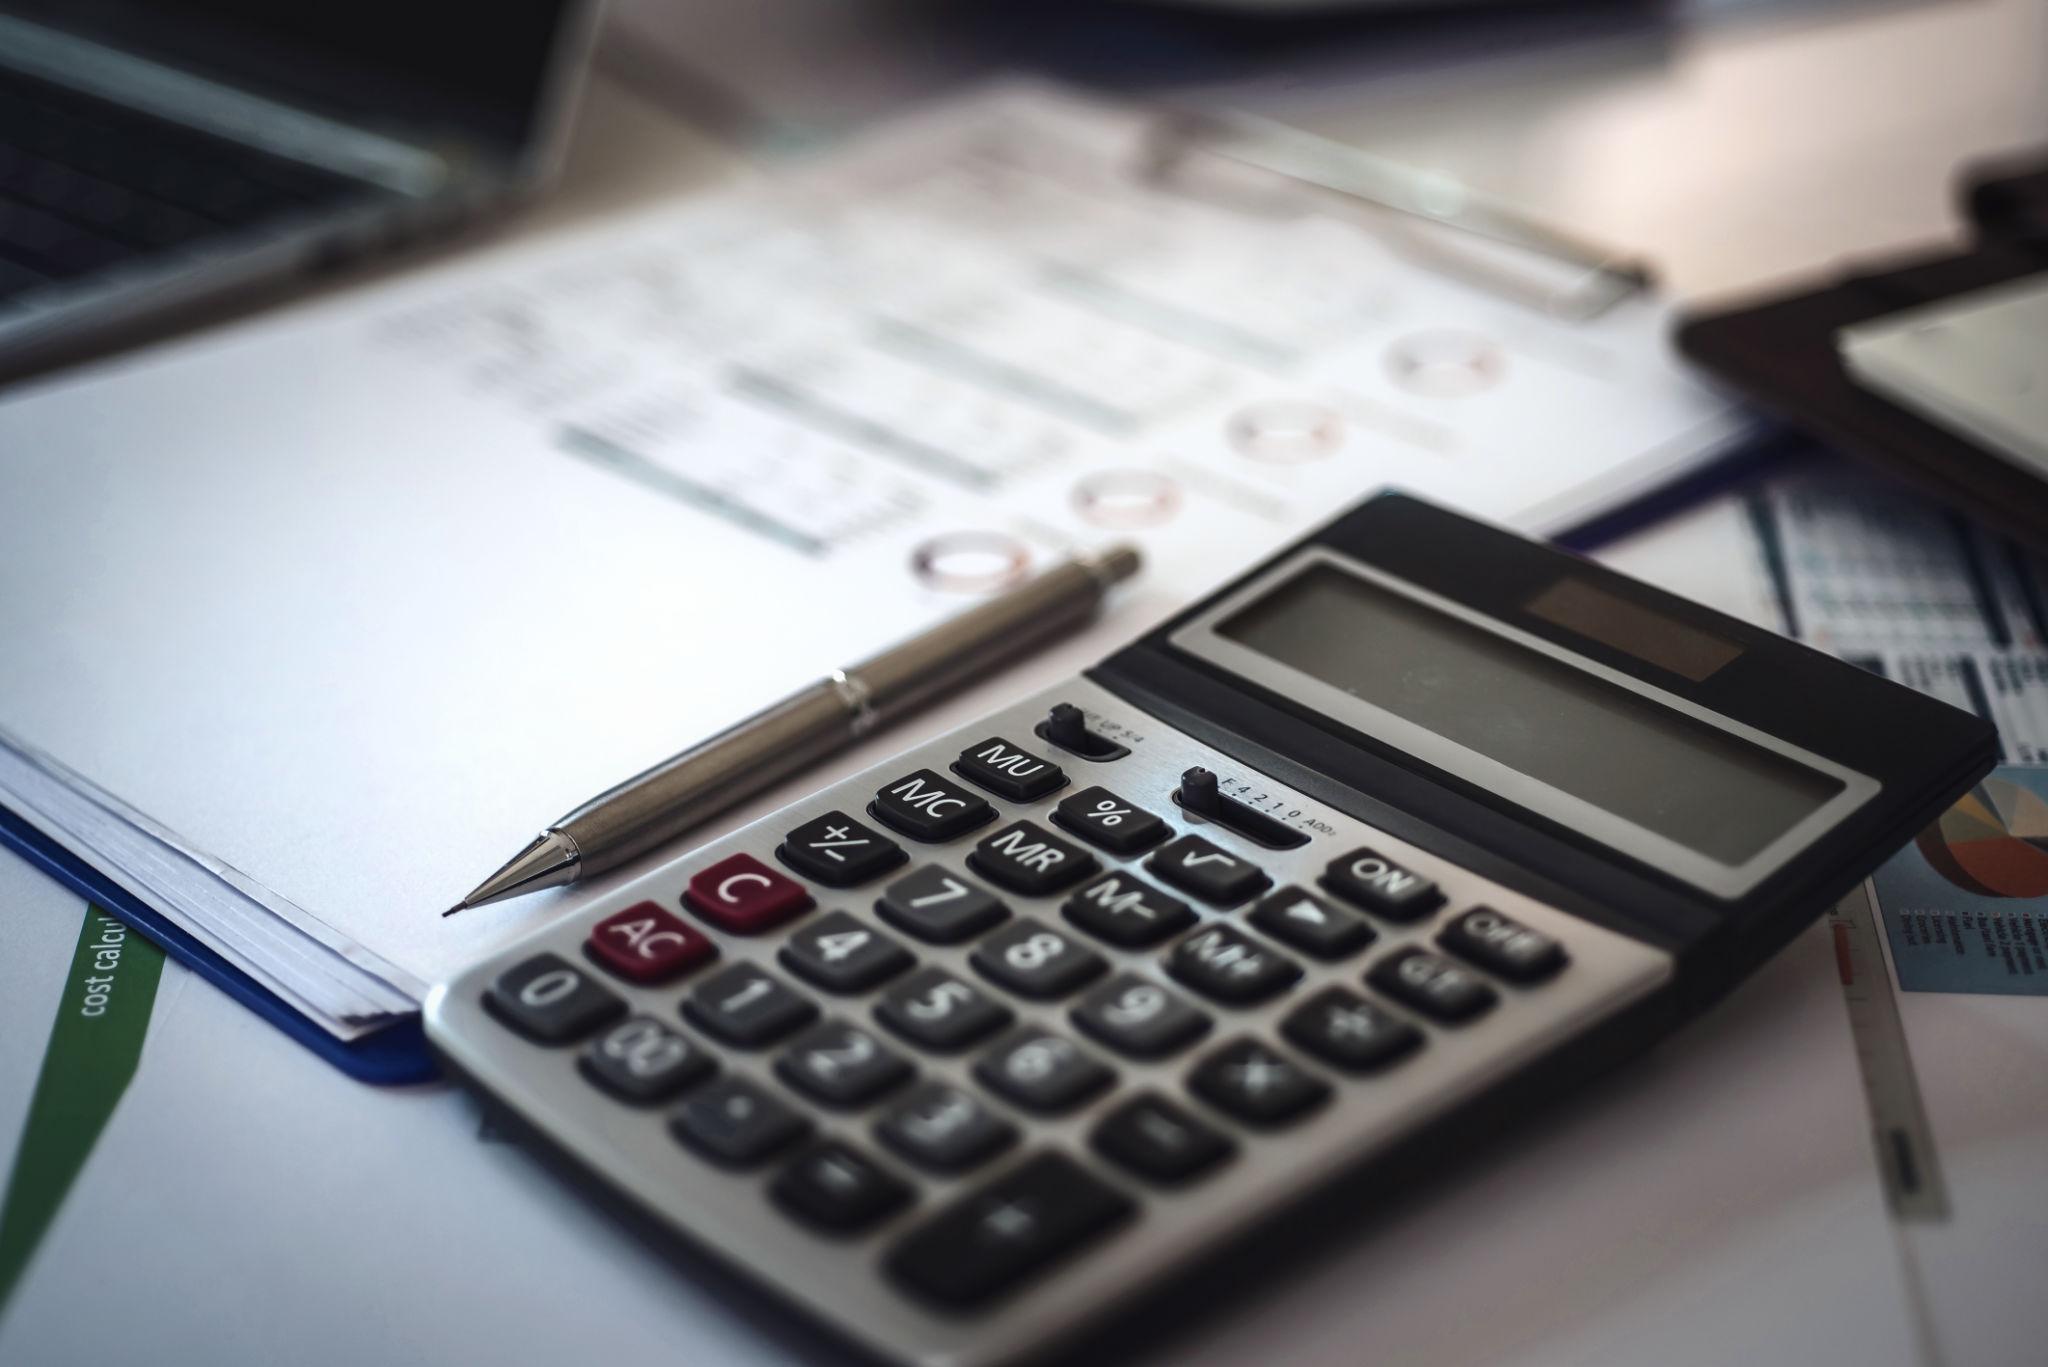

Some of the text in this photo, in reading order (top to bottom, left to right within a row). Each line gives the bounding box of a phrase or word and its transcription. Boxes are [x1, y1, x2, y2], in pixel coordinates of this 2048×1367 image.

[977, 744, 1045, 777] MU
[891, 778, 966, 818] MC
[1087, 799, 1131, 826] %
[1221, 778, 1236, 786] F
[1254, 793, 1268, 802] 2
[1272, 802, 1284, 810] 1
[1288, 810, 1301, 818] 0
[991, 829, 1064, 873] MR
[717, 872, 772, 904] C
[910, 878, 968, 908] 7
[1351, 857, 1415, 894] ON
[1085, 878, 1156, 919] M-
[609, 918, 685, 960] AC
[816, 929, 871, 962] 4
[1005, 932, 1065, 970] 8
[1463, 912, 1538, 951] OFF
[1186, 930, 1263, 977] M+
[81, 975, 114, 1017] cost
[520, 969, 579, 1006] 0
[719, 978, 772, 1013] 1
[906, 981, 972, 1020] 5
[1104, 985, 1166, 1026] 9
[602, 1022, 688, 1078] 00
[806, 1031, 876, 1074] 2
[1005, 1035, 1075, 1082] 6
[902, 1095, 971, 1144] 3
